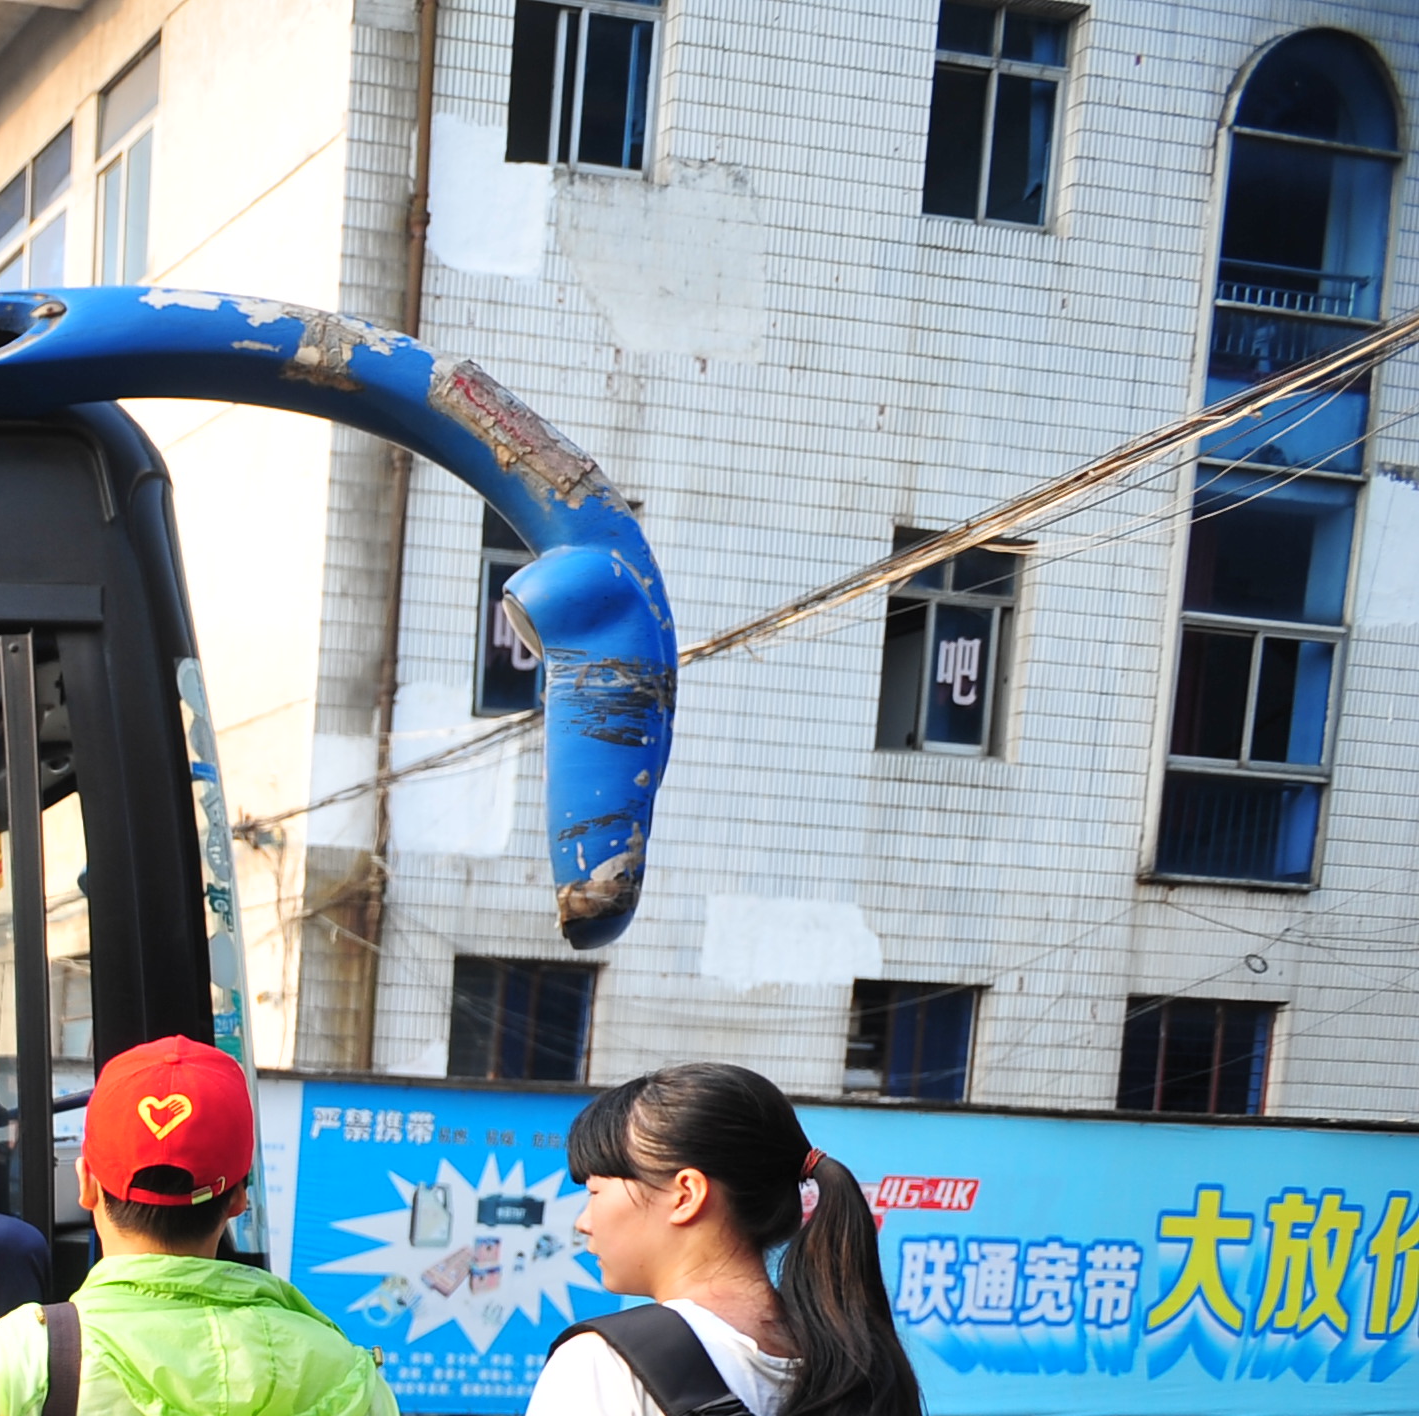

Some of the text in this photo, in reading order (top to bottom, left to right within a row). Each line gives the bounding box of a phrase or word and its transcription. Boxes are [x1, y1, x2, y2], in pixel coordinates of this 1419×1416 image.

[310, 1106, 435, 1144] 严禁携带
[896, 1241, 1141, 1324] 联通宽带
